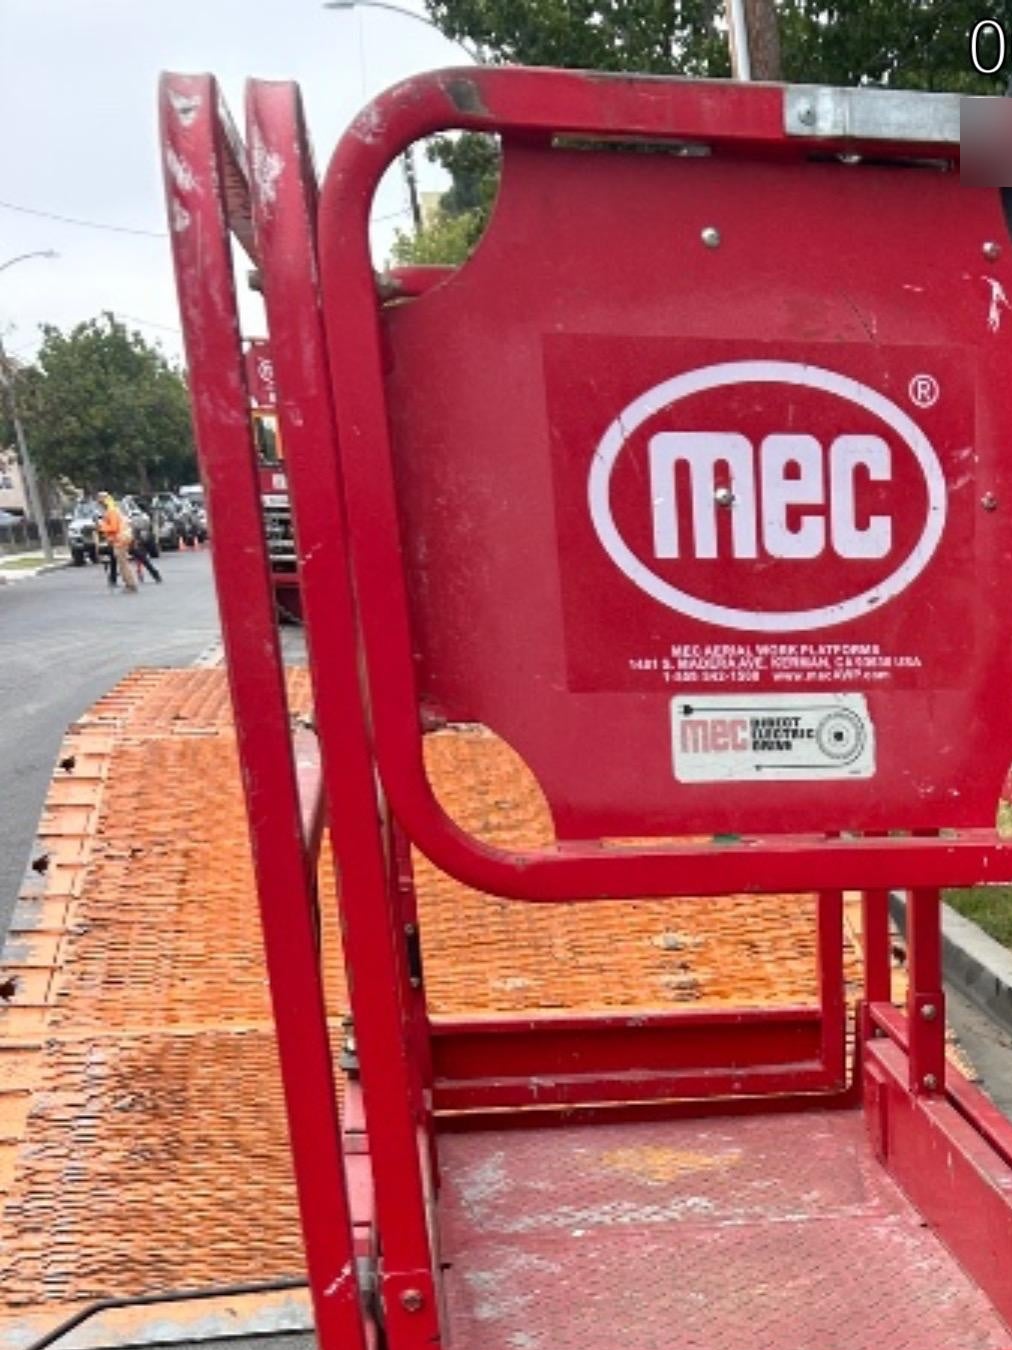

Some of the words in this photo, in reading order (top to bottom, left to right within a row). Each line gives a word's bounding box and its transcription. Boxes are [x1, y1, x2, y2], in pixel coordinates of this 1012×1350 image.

[671, 644, 700, 658] MEC
[800, 643, 880, 655] PLATFORMS
[750, 716, 802, 728] DIRECT
[751, 728, 815, 739] ELECTRIC
